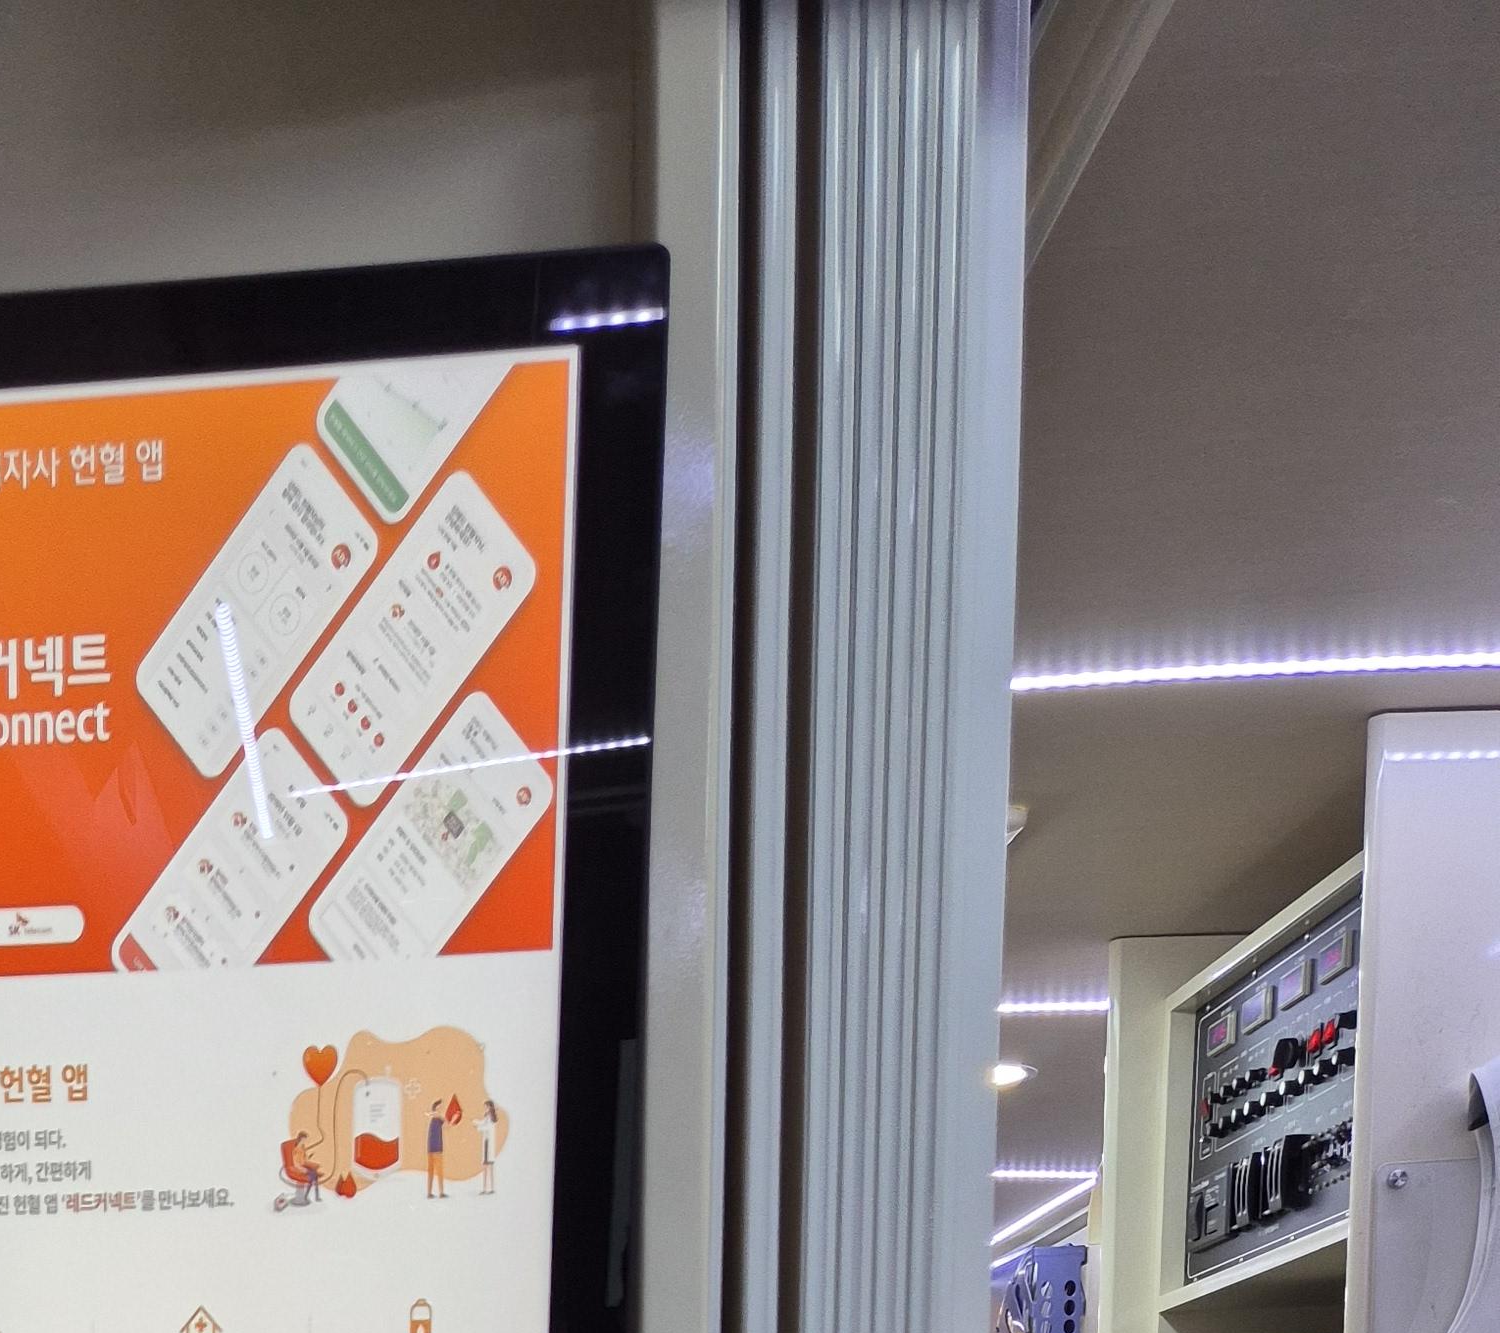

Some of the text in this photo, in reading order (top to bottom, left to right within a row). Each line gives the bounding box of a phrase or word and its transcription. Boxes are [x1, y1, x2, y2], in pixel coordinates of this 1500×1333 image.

[70, 442, 125, 486] 헌혈
[135, 439, 164, 482] 앱
[61, 1062, 89, 1103] 앱
[34, 1128, 67, 1151] 되다.
[35, 1159, 92, 1183] 간편하게
[13, 1195, 41, 1216] 헌혈
[44, 1194, 59, 1215] 앱
[158, 1186, 236, 1211] 만나보세요.
